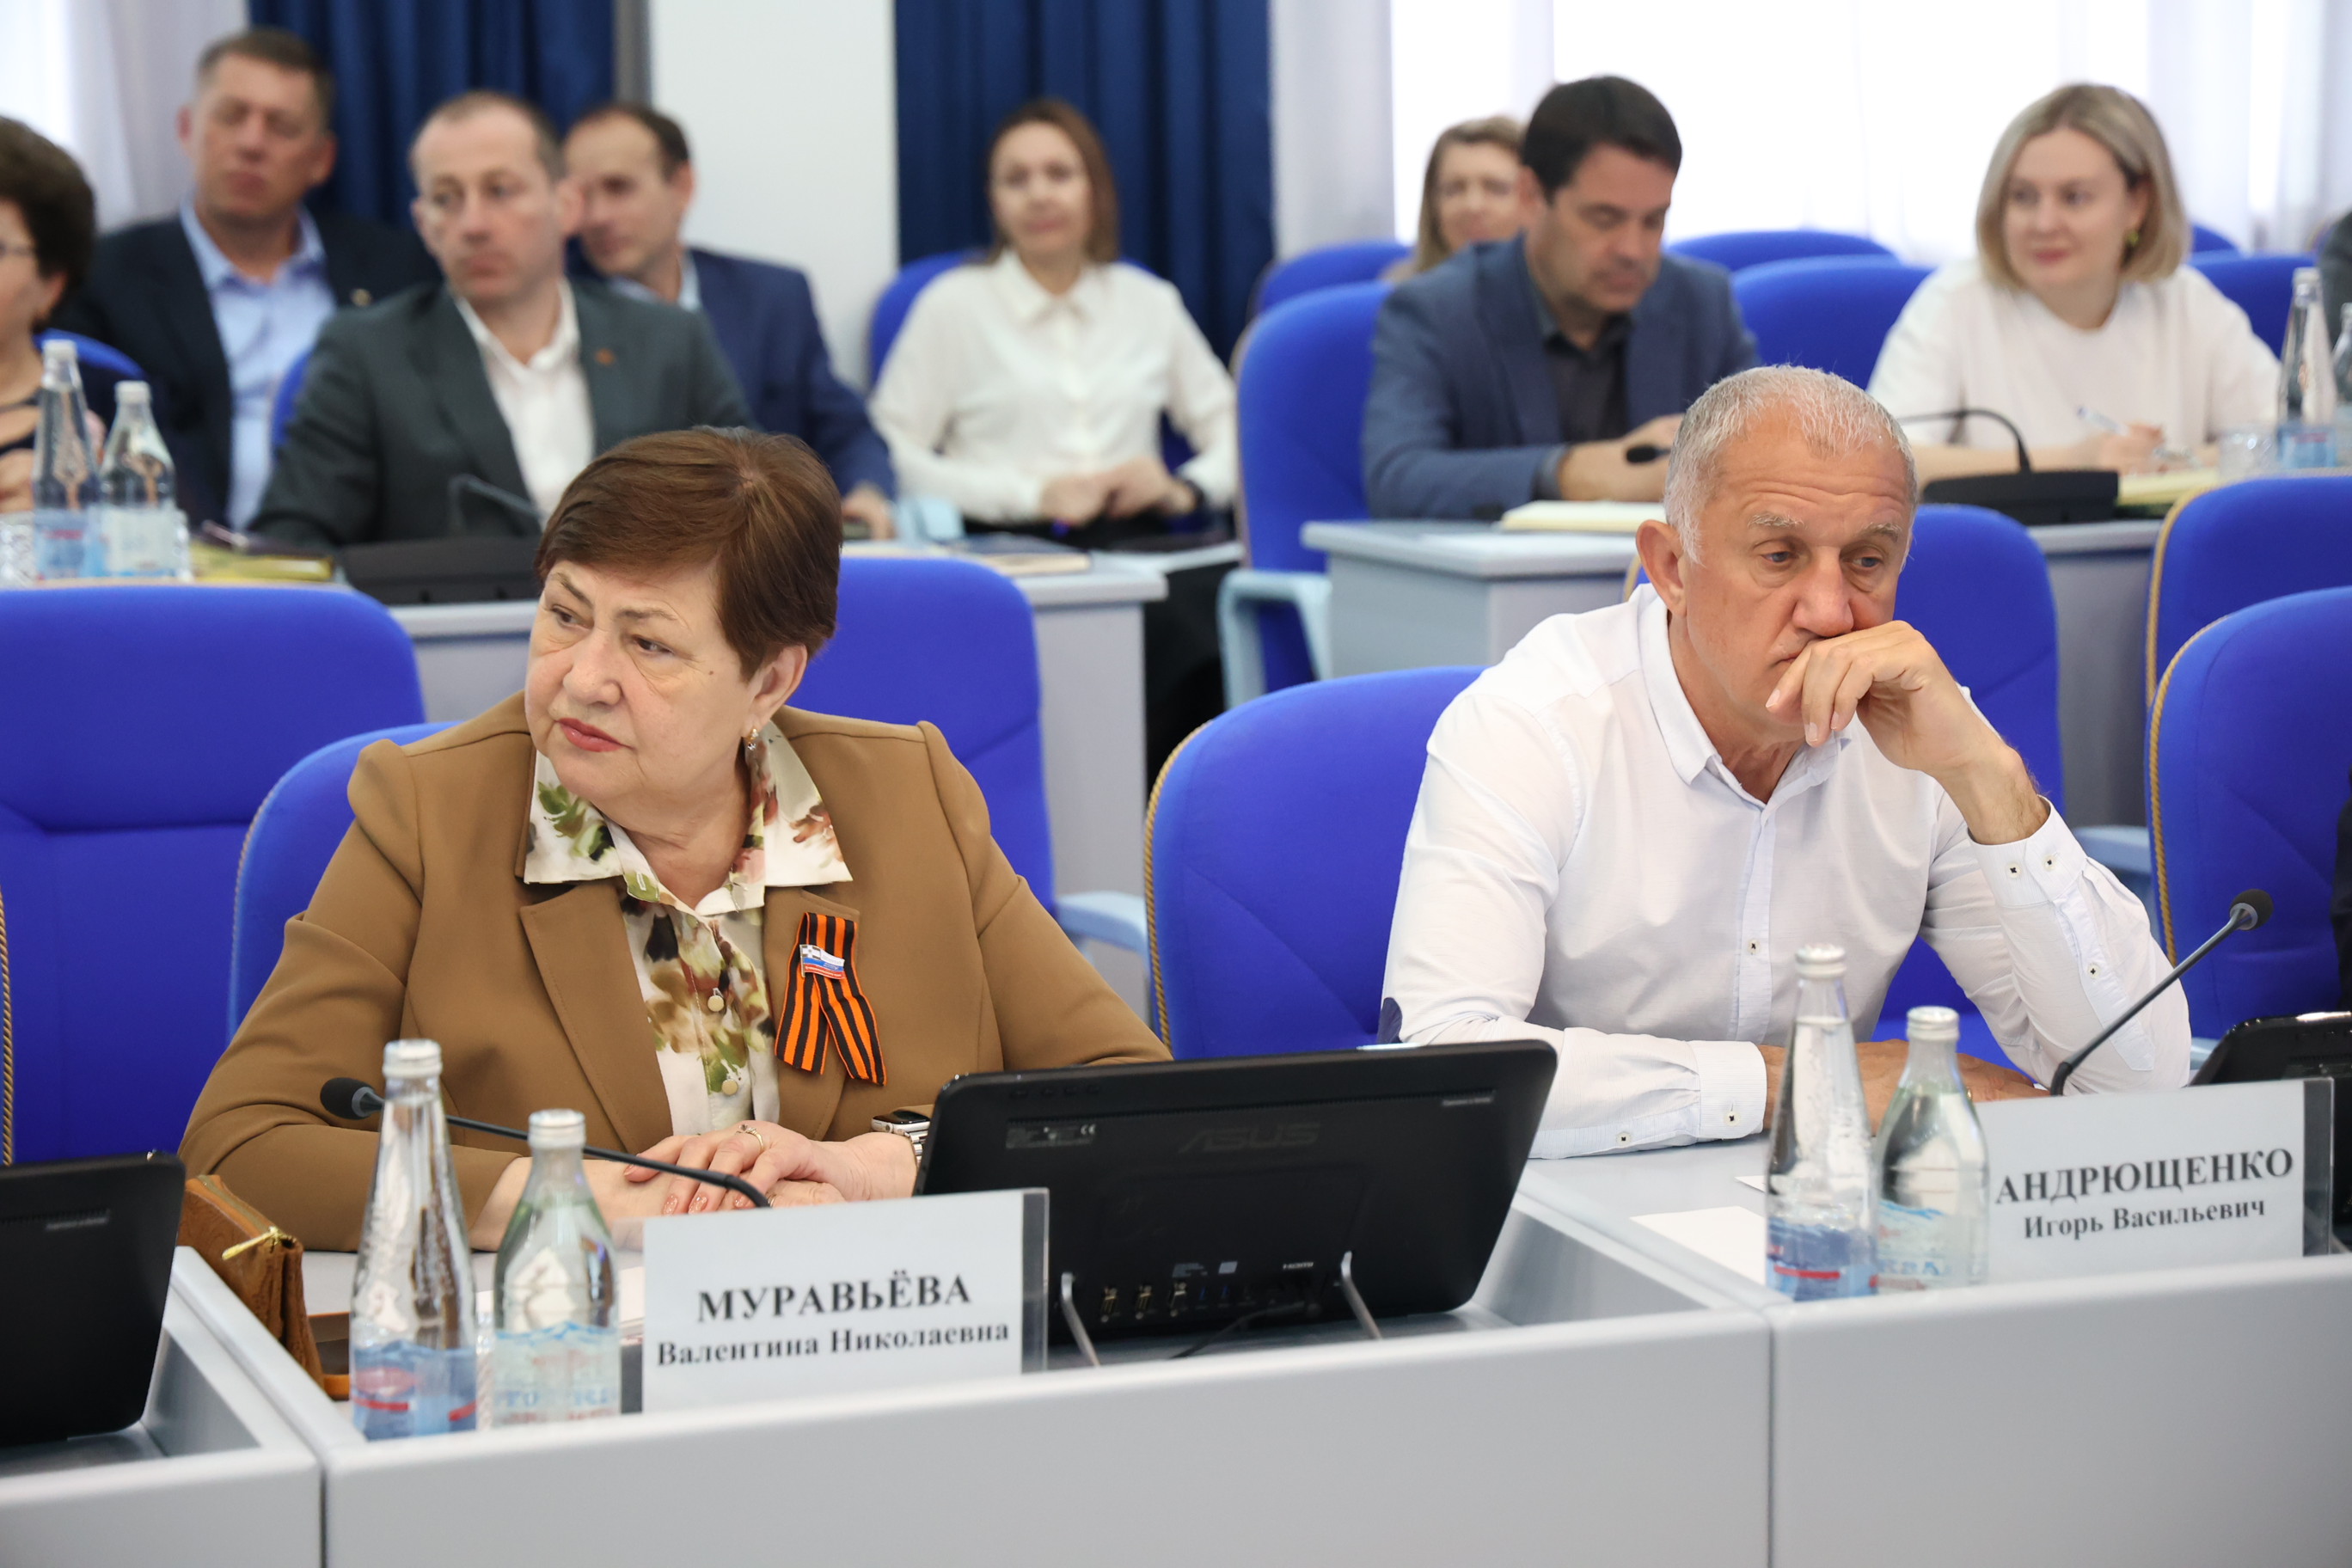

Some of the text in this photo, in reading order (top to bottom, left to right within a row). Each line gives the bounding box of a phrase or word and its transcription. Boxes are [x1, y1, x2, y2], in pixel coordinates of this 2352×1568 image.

[1180, 1124, 1321, 1154] ASUS
[1995, 1148, 2293, 1204] АНДРЮЩЕНКО
[2024, 1199, 2265, 1240] Игорь Васильевич
[697, 1270, 971, 1322] МУРАВЬЁВА
[657, 1323, 1009, 1365] Валентина Николаевна
